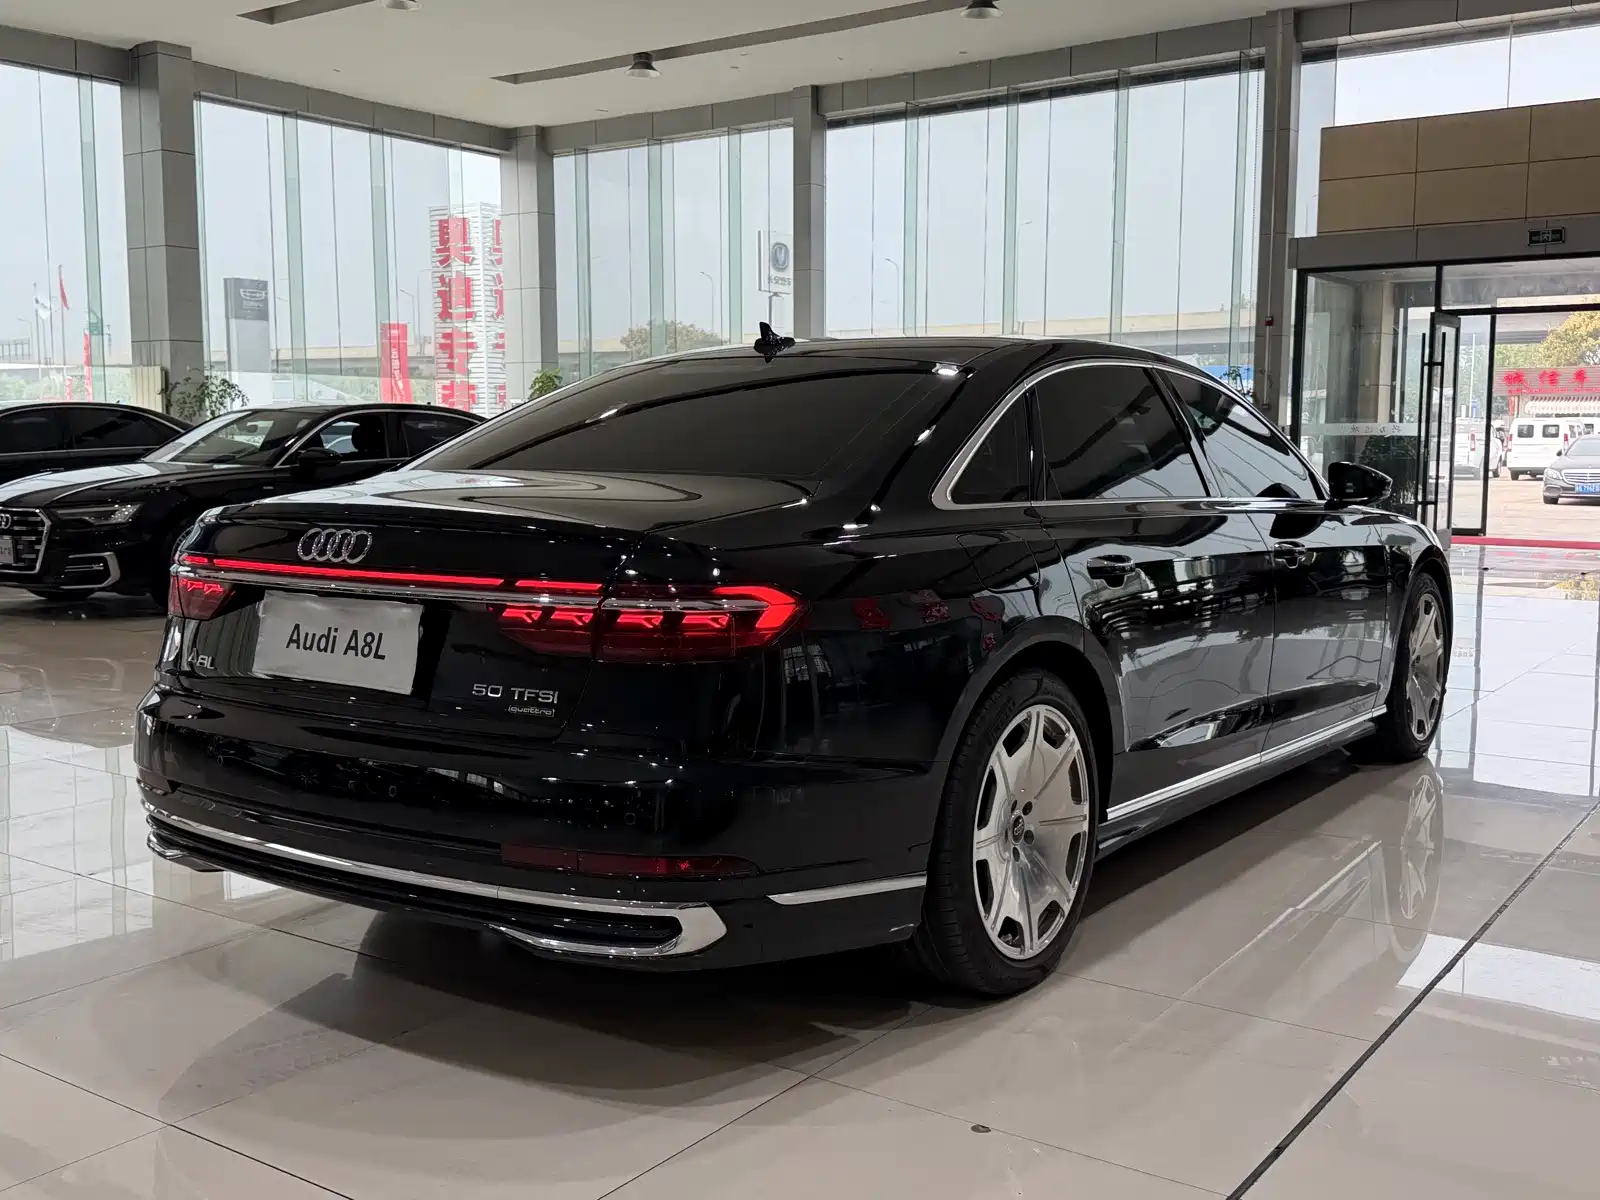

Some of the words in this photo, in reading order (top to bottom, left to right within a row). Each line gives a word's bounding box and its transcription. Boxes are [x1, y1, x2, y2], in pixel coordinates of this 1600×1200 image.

[286, 623, 337, 654] Audi
[343, 629, 386, 660] A8L
[187, 648, 216, 670] A8L
[472, 683, 503, 698] 50
[510, 687, 559, 704] TFSI
[508, 705, 555, 716] quattro
